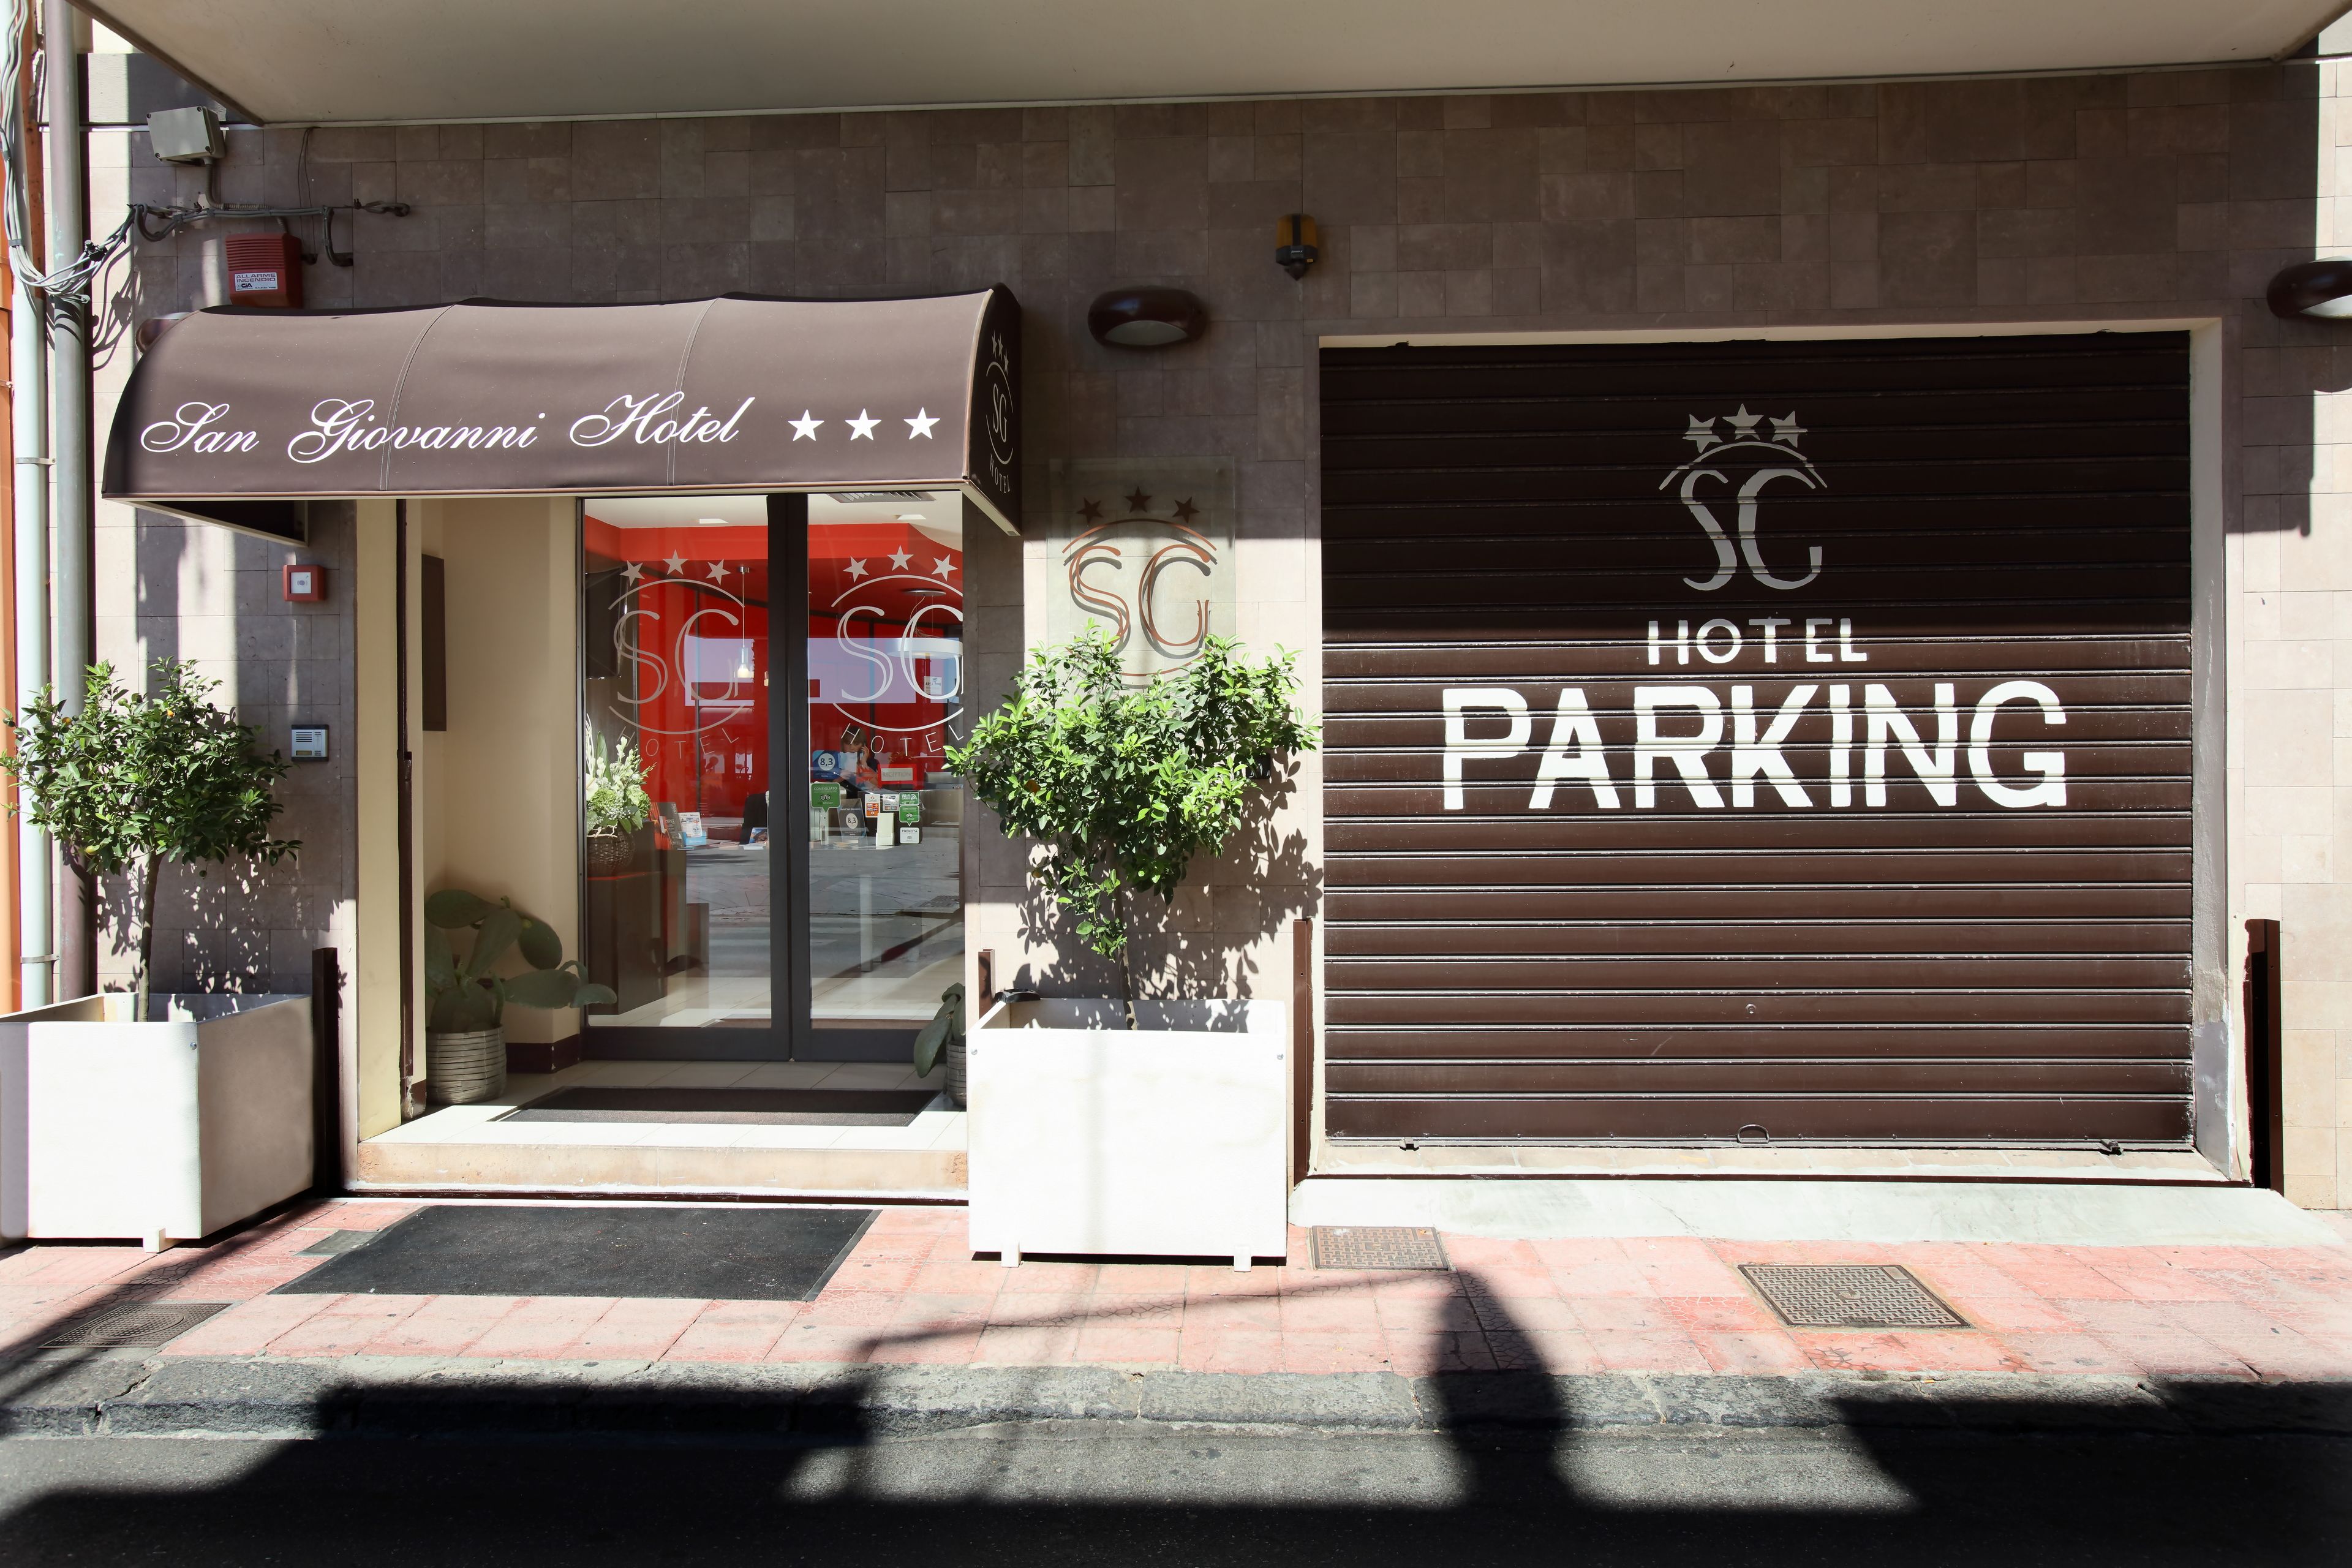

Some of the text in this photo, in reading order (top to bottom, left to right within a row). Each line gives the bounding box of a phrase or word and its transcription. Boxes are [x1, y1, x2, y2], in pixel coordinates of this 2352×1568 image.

[141, 391, 755, 463] San Giovanni Hotel
[989, 453, 1011, 494] HOTEL
[1648, 617, 1868, 665] HOTEL
[617, 726, 739, 760] HOTEL
[841, 723, 964, 756] HOTEL
[1442, 680, 2068, 810] PARKING
[820, 758, 833, 767] 8,3
